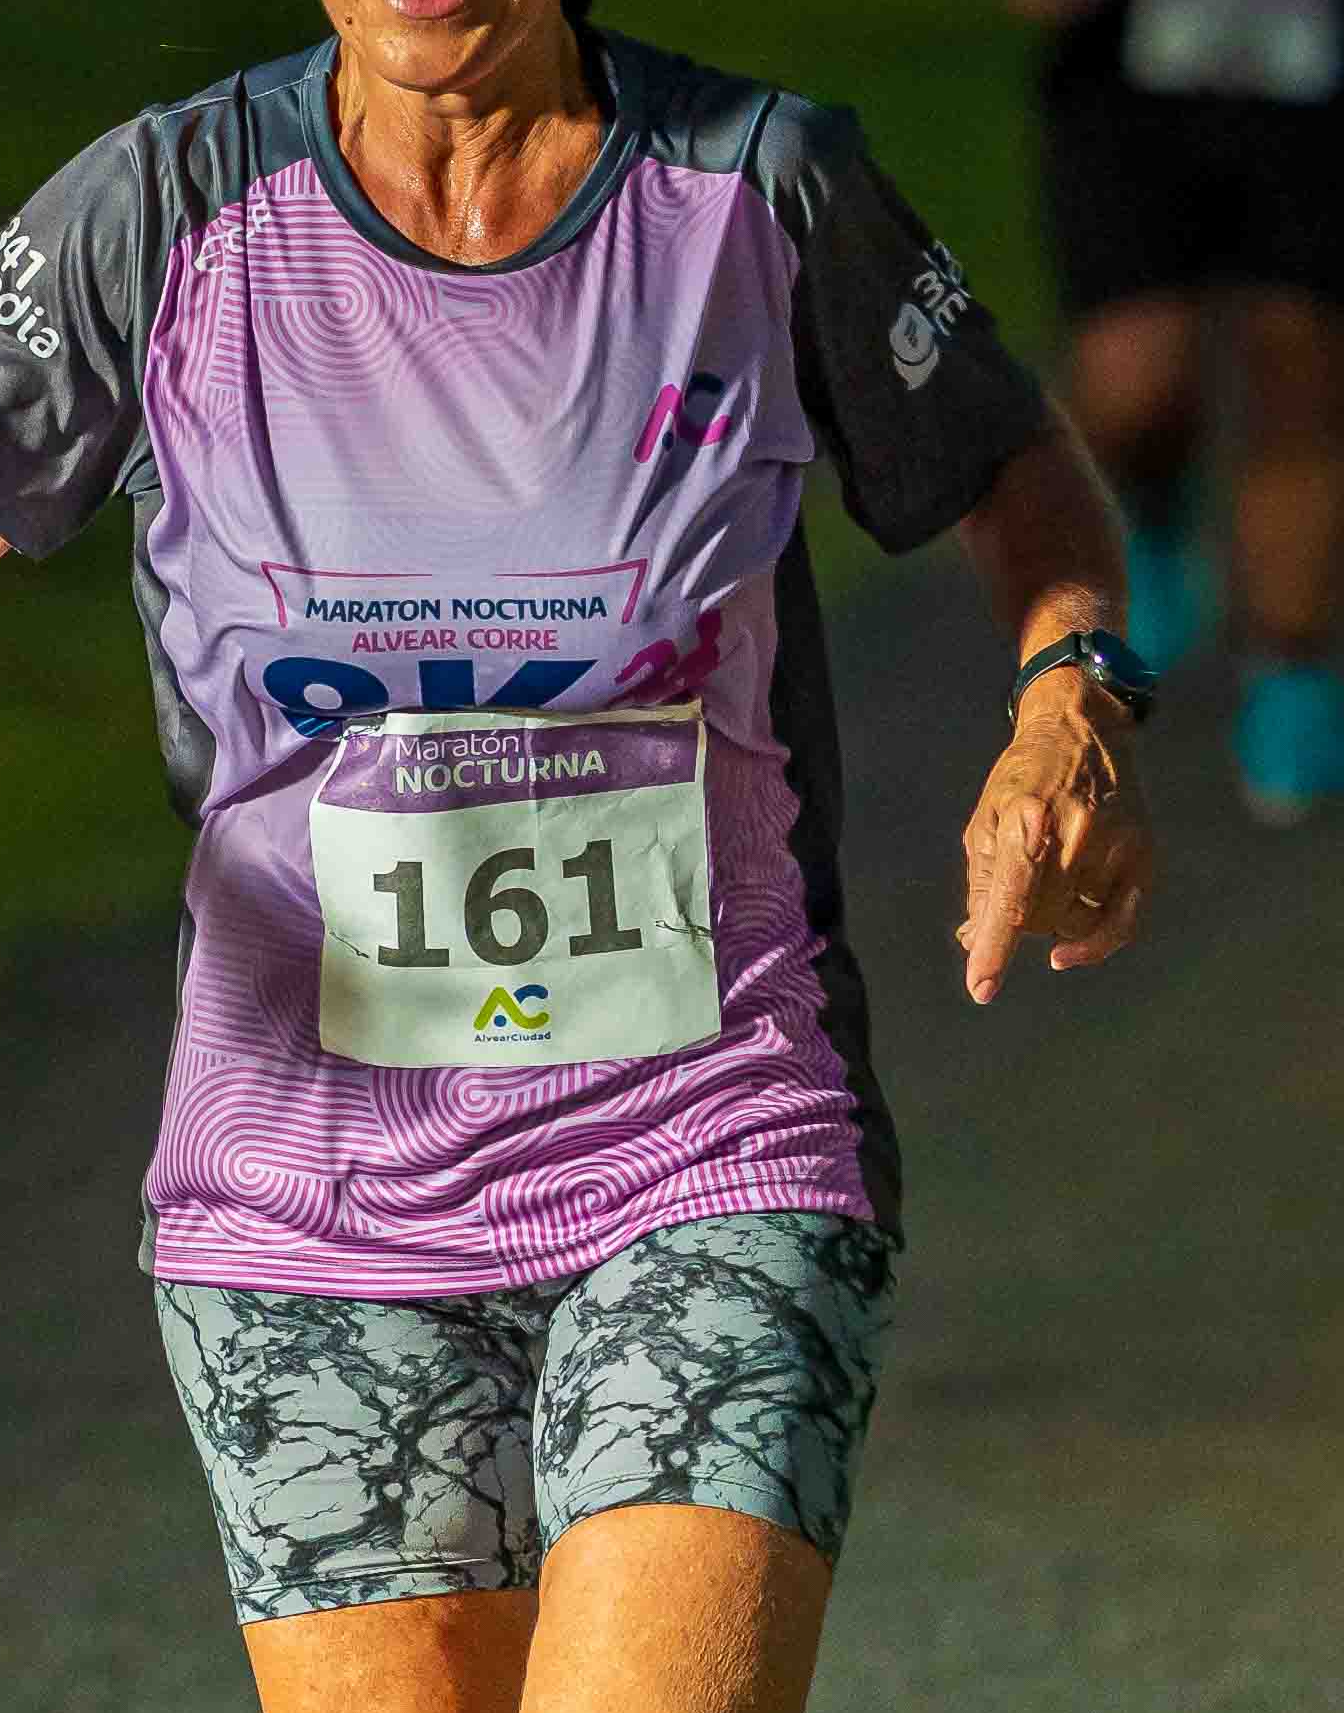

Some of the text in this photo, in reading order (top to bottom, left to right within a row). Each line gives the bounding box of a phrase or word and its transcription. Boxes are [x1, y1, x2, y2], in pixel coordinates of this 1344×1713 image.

[305, 596, 607, 623] MARATON NOCTURNA
[352, 629, 559, 653] ALVEAR CORRE
[394, 730, 519, 761] Maratón
[394, 749, 606, 794] NOCTURNA
[373, 839, 643, 968] 161
